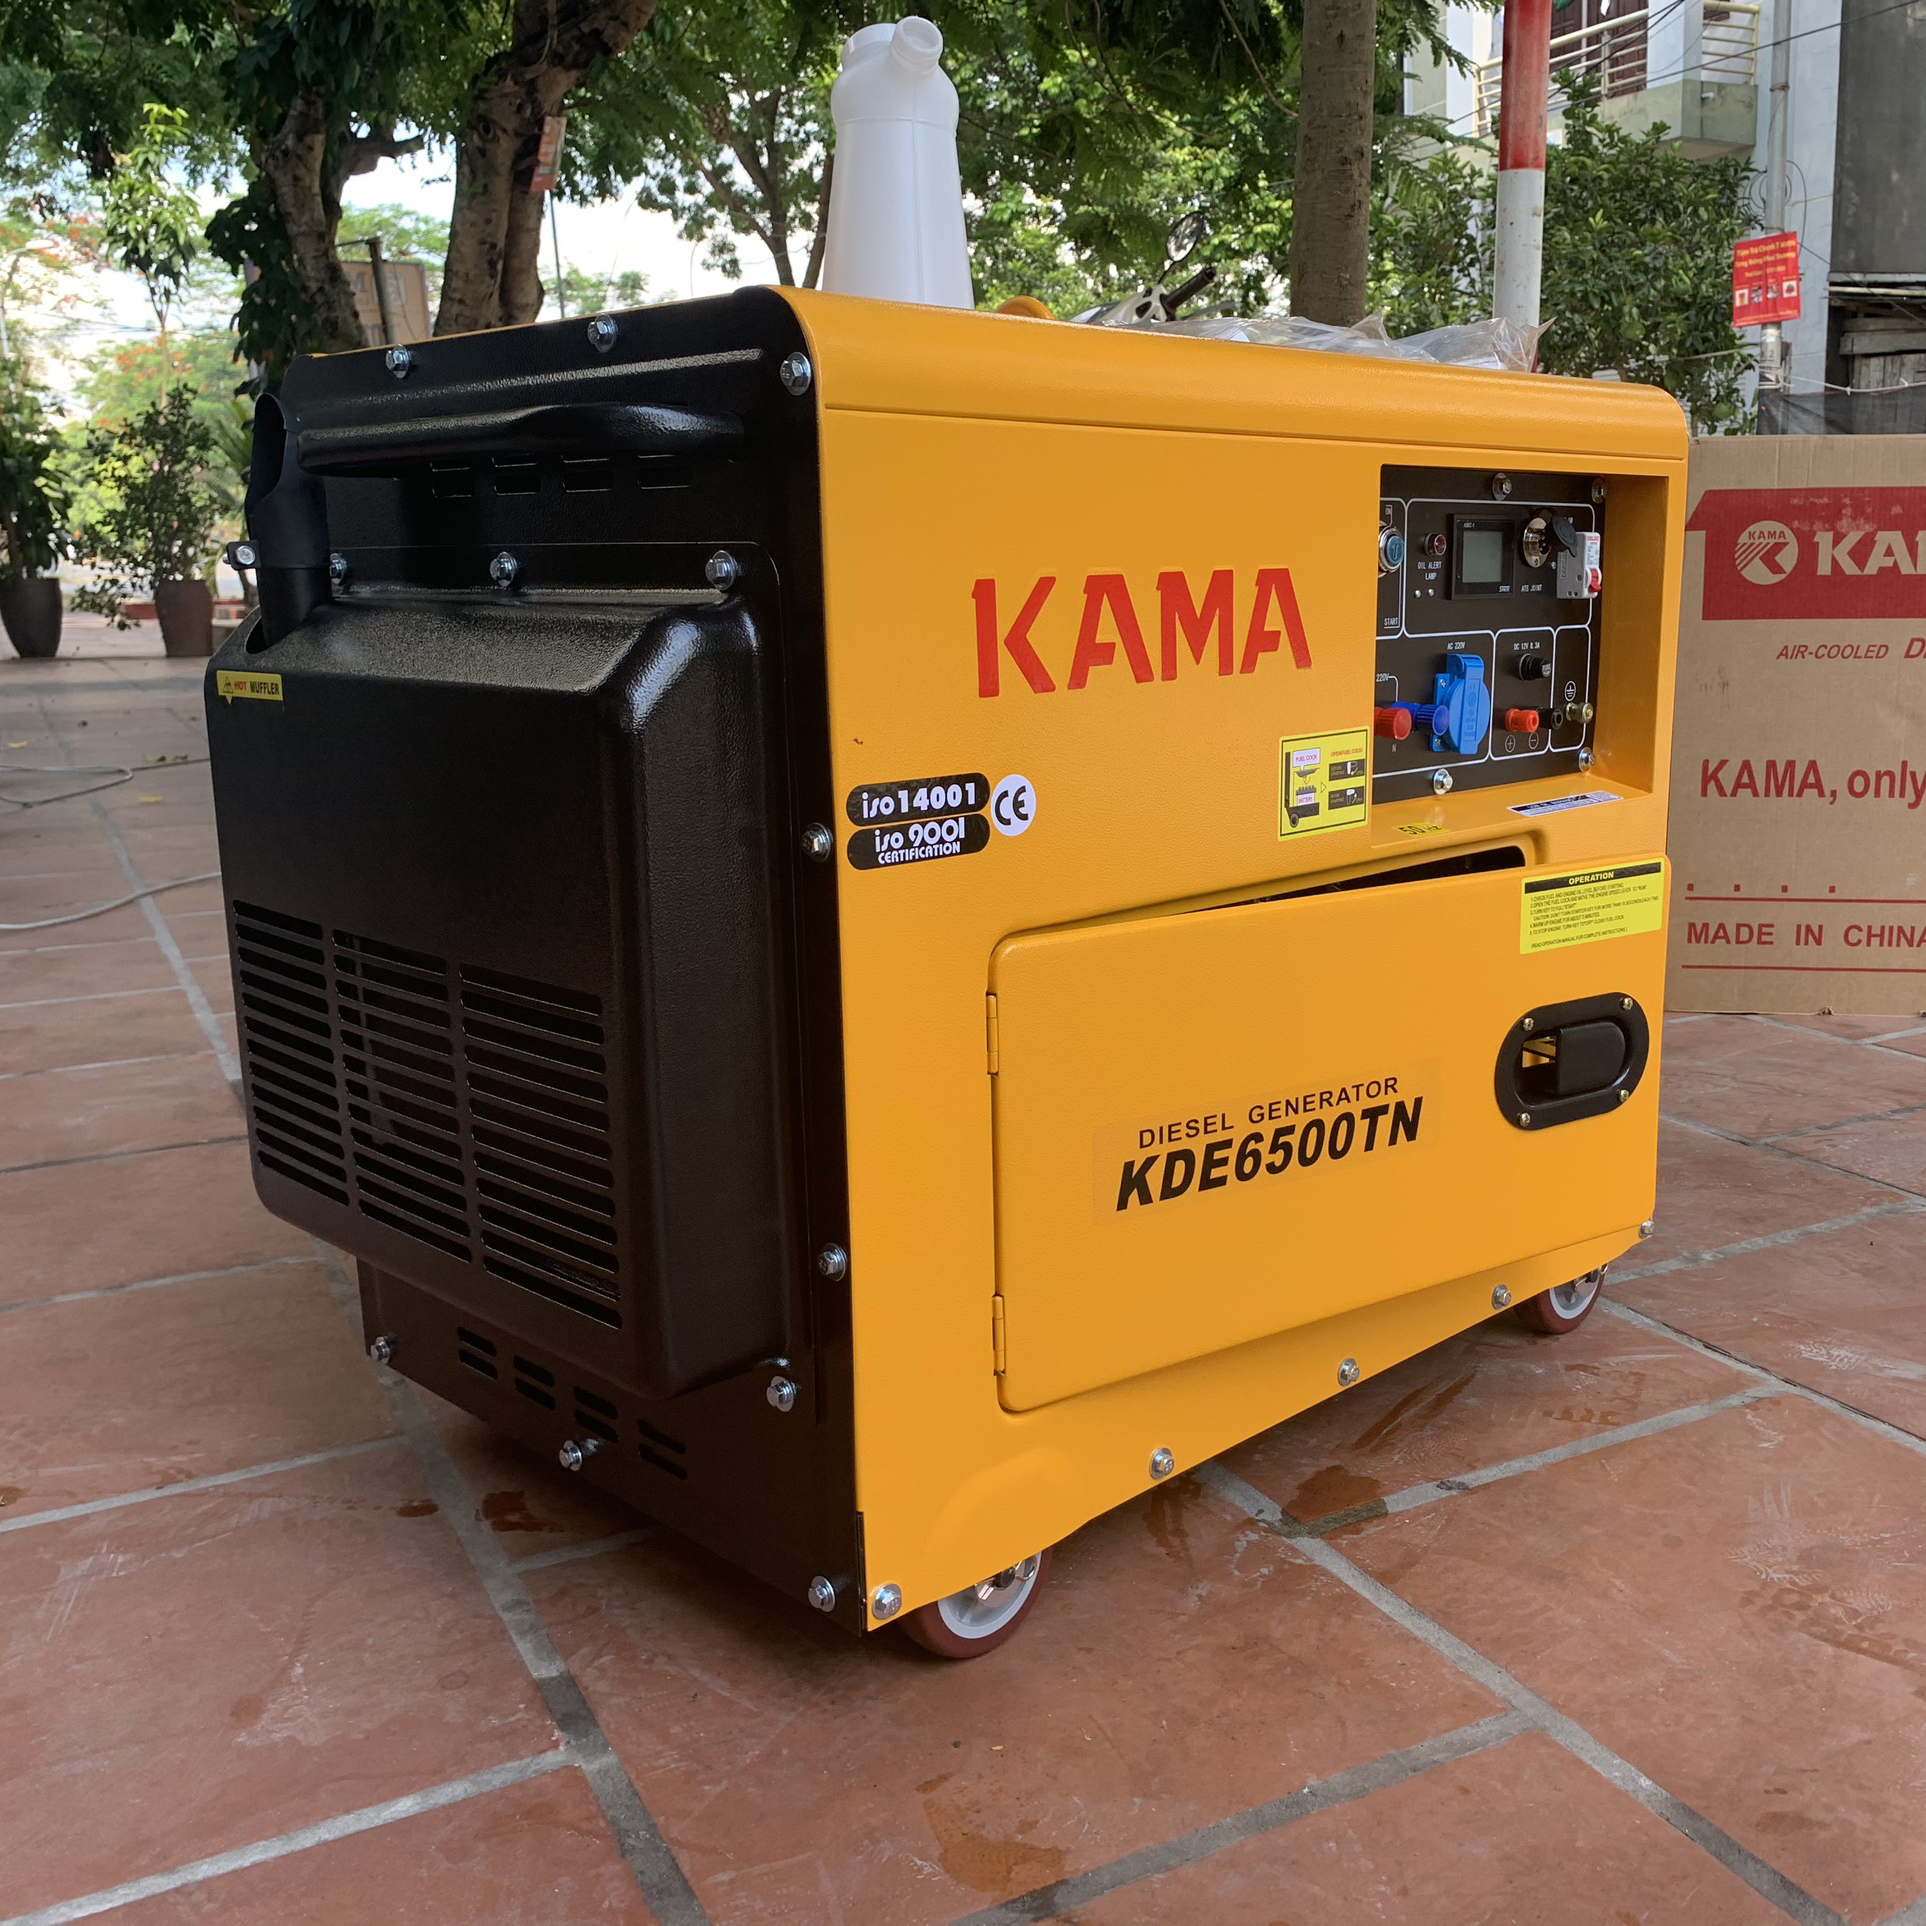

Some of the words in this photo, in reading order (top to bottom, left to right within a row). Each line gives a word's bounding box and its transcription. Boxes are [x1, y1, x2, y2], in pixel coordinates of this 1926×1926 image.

[1748, 530, 1786, 540] KAMA
[1814, 530, 1926, 576] KA
[971, 568, 1312, 698] KAMA
[1384, 618, 1398, 626] START
[1514, 642, 1520, 650] DC
[1776, 644, 1889, 660] AIR-COOLED
[234, 681, 247, 690] HOT
[250, 681, 280, 695] MUFFLER
[1701, 759, 1837, 805] KAMA,
[862, 792, 894, 818] iso
[898, 782, 976, 813] 14001
[874, 829, 904, 852] iso
[908, 817, 965, 847] 9001
[877, 842, 960, 864] CERTIFICATION
[1568, 871, 1614, 885] OPERATION
[1687, 922, 1775, 945] MADE
[1795, 924, 1824, 946] IN
[1139, 1112, 1234, 1149] DIESEL
[1248, 1076, 1399, 1124] GENERATOR
[1116, 1096, 1424, 1212] KDE6500TN
